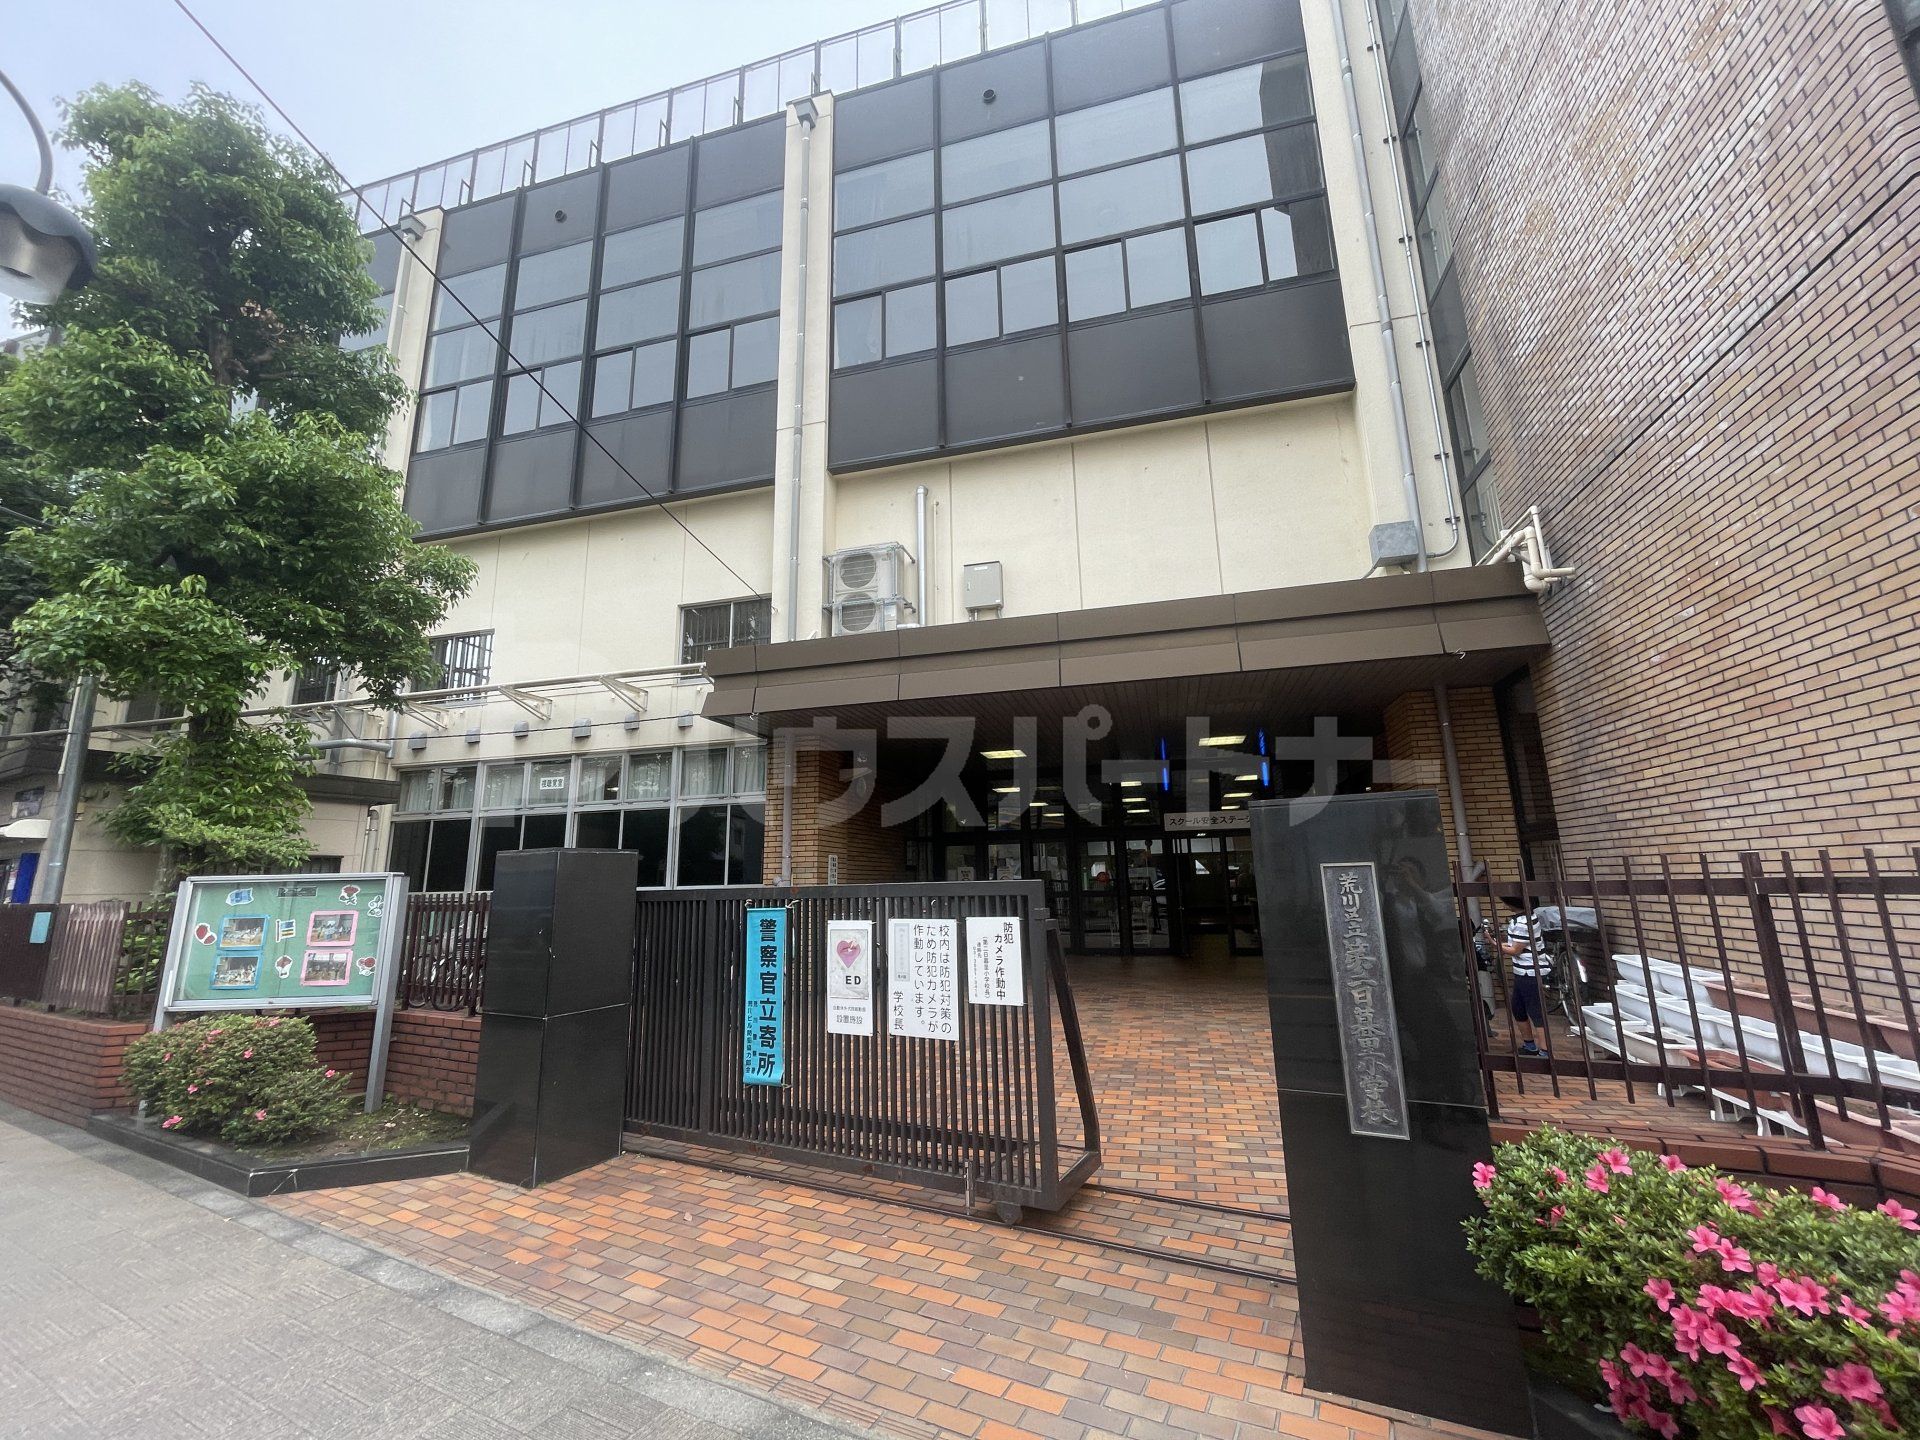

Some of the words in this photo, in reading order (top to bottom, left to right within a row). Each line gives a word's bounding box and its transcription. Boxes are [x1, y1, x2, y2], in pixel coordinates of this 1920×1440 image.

[913, 924, 926, 1025] 作動しています。
[926, 924, 939, 1033] ため防犯カメラが
[938, 924, 952, 1034] 校内は防犯対策の
[994, 934, 1006, 1001] カメラ作動中
[1003, 922, 1014, 944] 防犯
[756, 918, 778, 1078] 警察官立寄所
[893, 990, 905, 1031] 学校長
